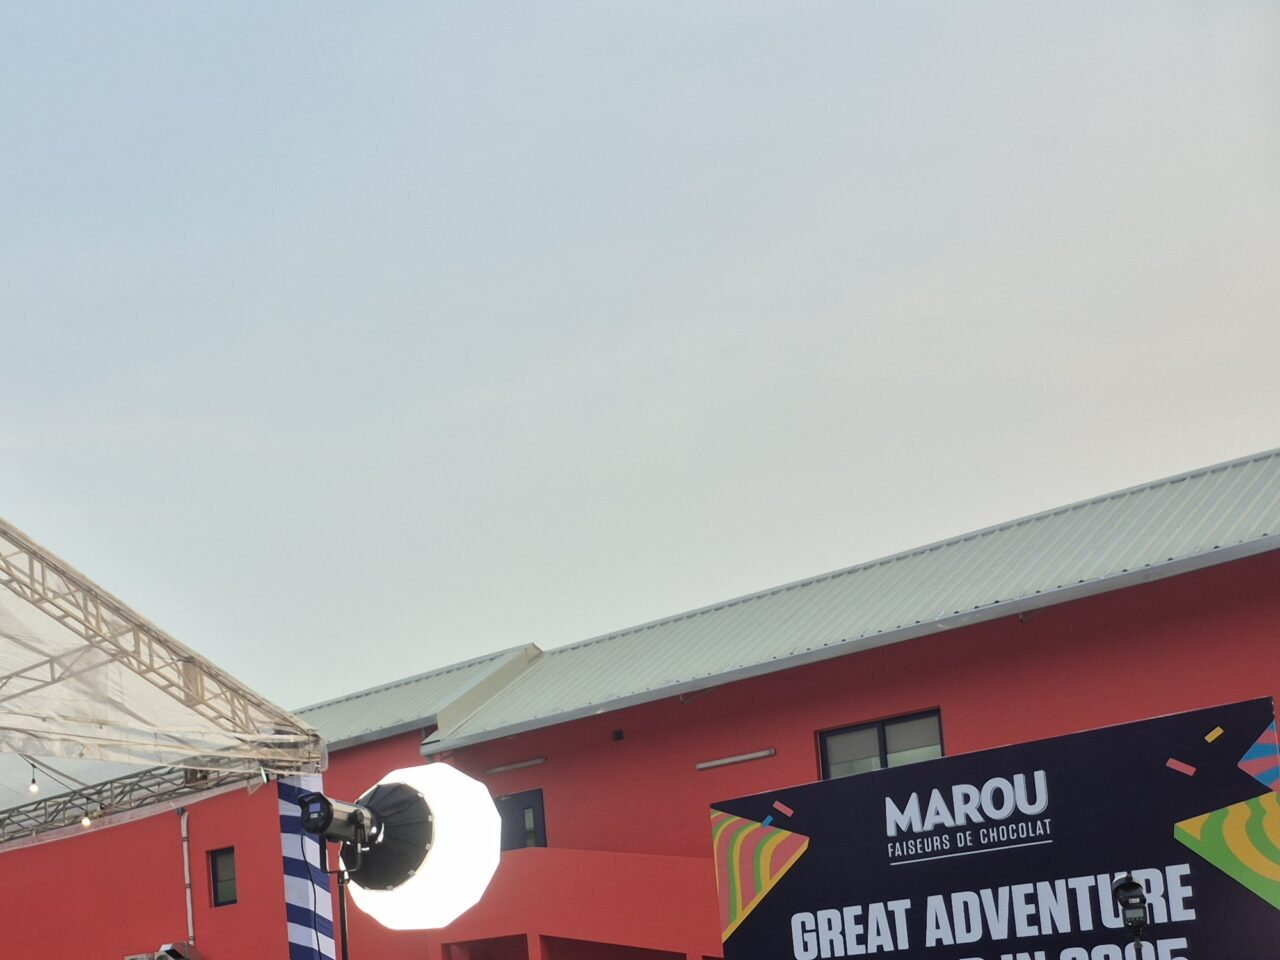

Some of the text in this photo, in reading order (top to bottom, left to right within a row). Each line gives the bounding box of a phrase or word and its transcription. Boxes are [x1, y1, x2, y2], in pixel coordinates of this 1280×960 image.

[885, 770, 1049, 837] MAROU
[887, 818, 1051, 858] FAISEURS DE CHOCOLAT
[925, 863, 1197, 948] ADVENTURE
